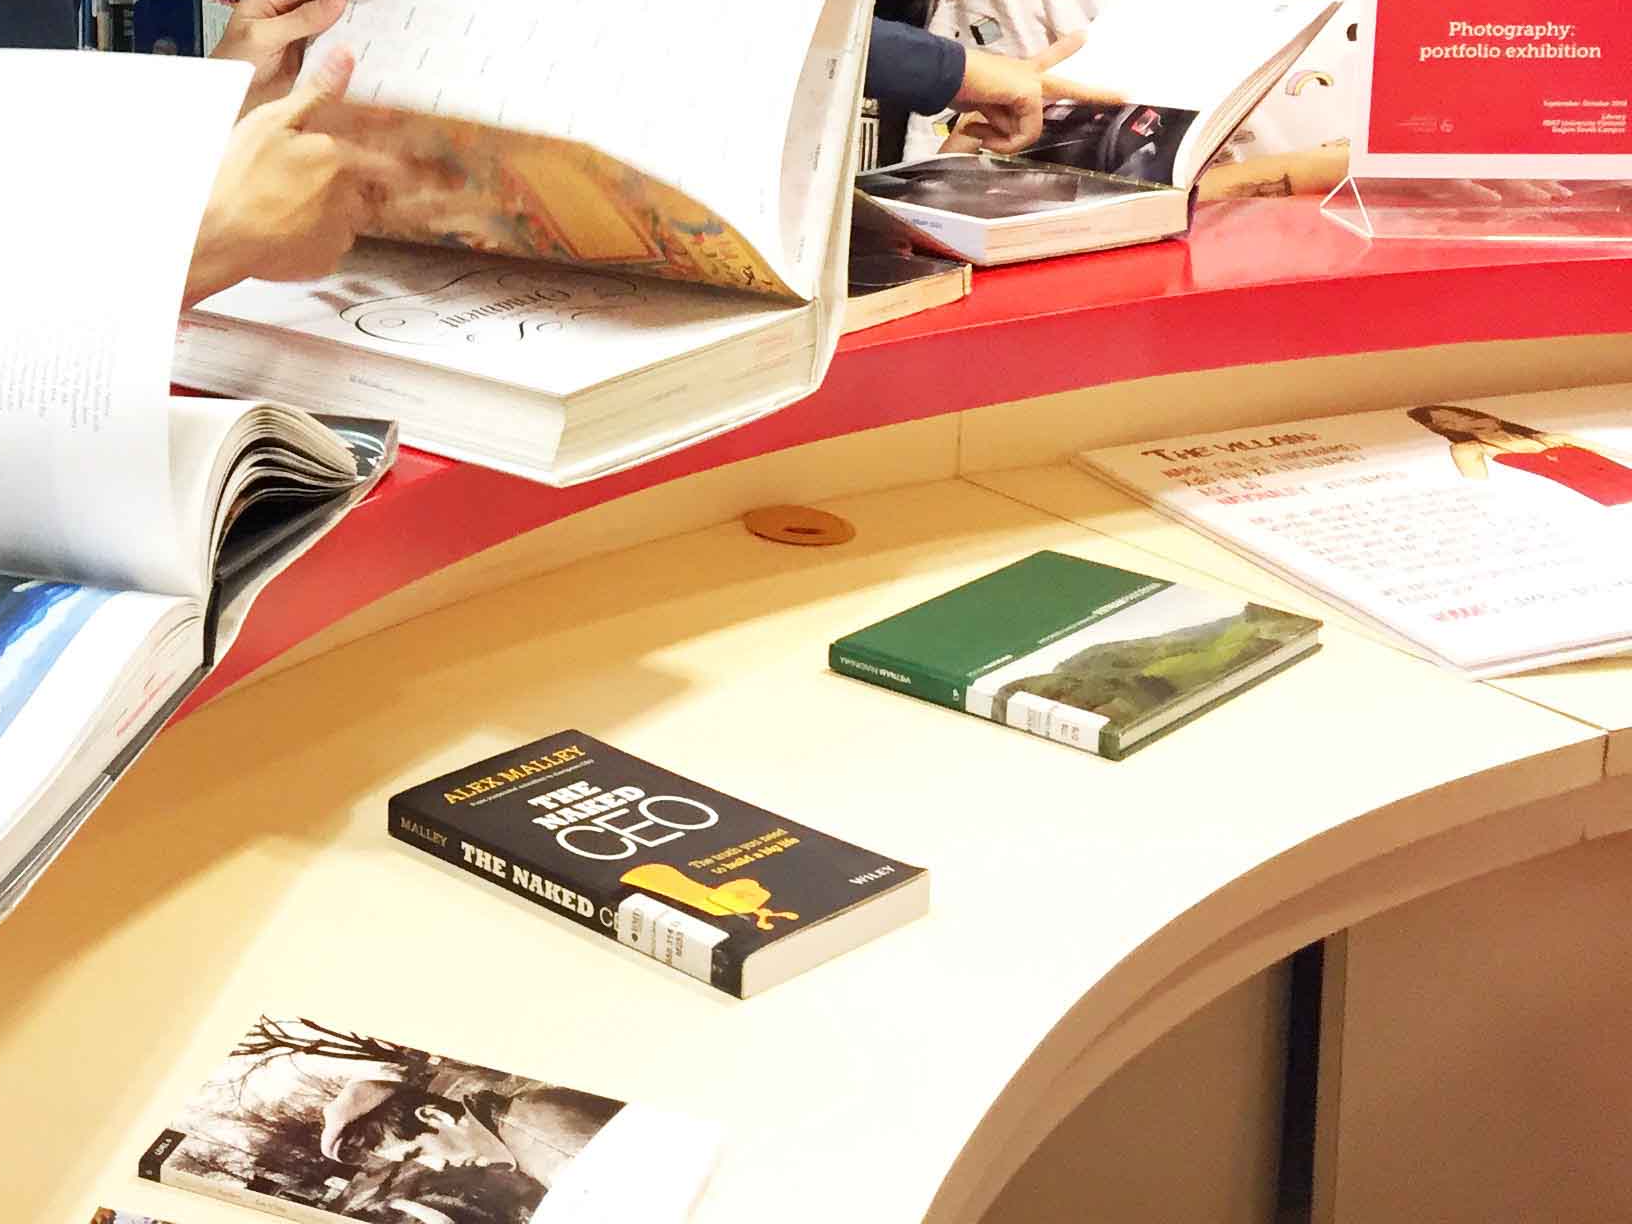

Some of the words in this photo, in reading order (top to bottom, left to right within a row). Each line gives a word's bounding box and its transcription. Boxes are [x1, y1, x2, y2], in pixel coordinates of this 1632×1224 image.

[1448, 20, 1576, 41] Photography:
[1419, 43, 1501, 61] portfolio
[1505, 42, 1601, 59] exhibition
[443, 772, 505, 805] ALEX
[499, 744, 587, 782] MALLEY
[527, 780, 602, 810] THE
[531, 785, 647, 831] NAKED
[400, 816, 449, 848] MALLEY
[555, 795, 719, 860] CEO
[461, 841, 505, 879] THE
[513, 865, 595, 919] NAKED
[848, 864, 896, 886] WILEY
